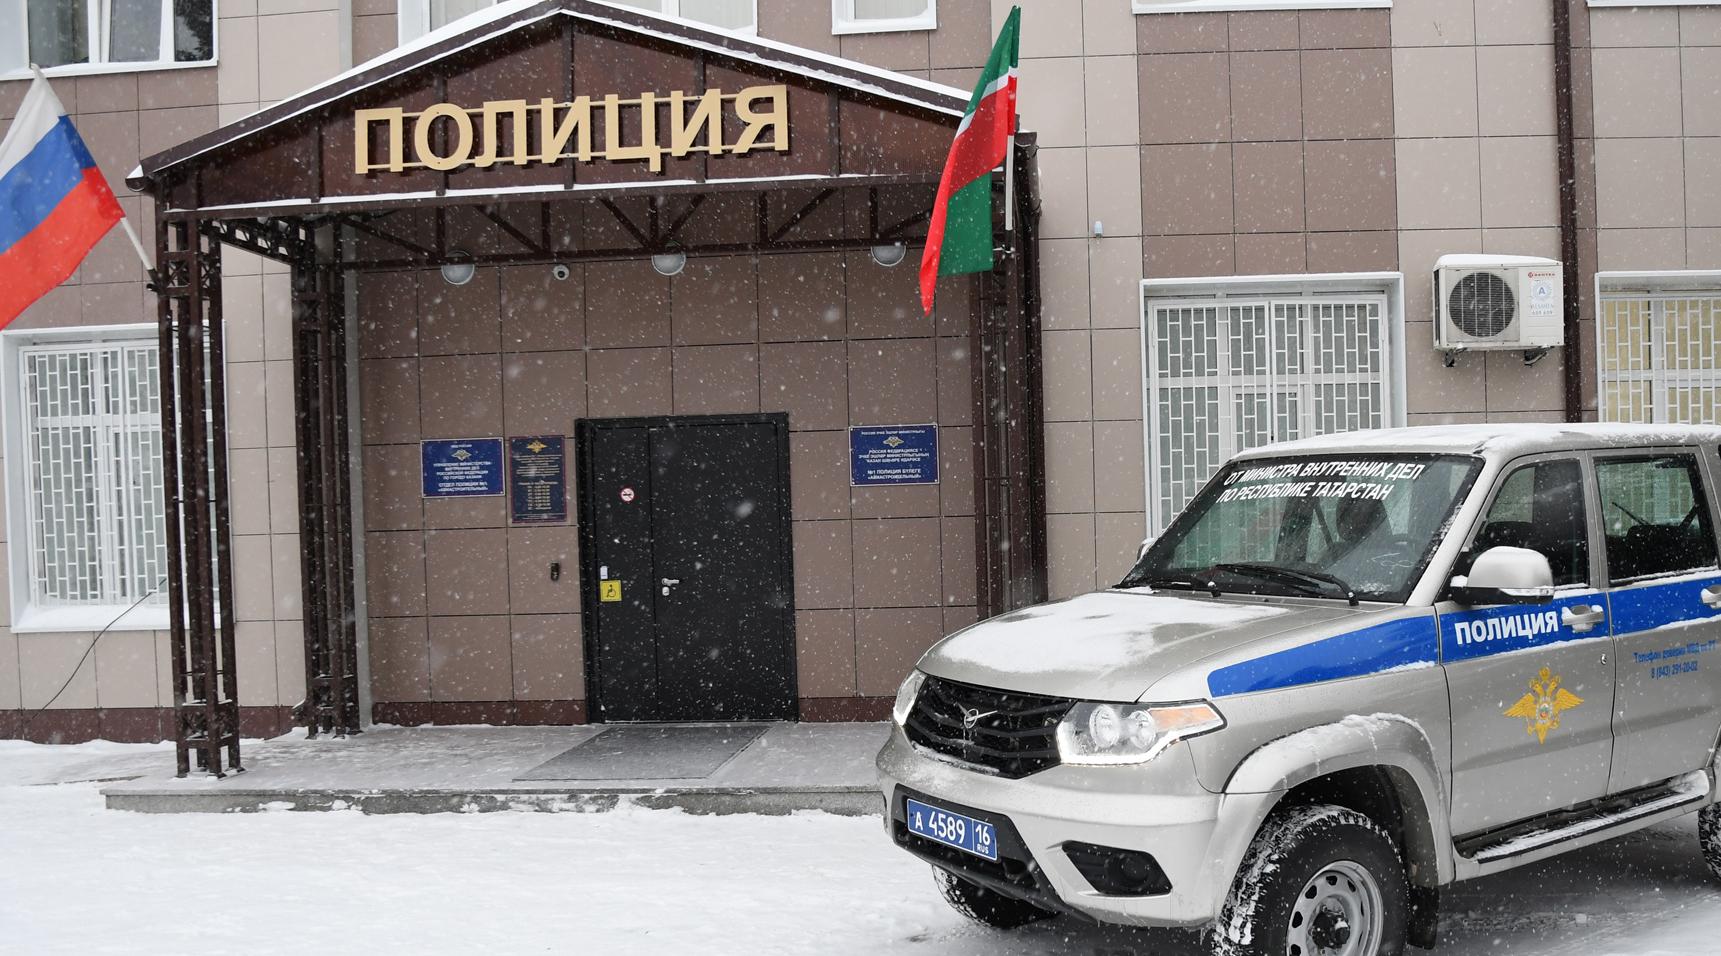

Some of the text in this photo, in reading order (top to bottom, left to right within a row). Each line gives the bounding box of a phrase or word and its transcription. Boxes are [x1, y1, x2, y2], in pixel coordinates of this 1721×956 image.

[355, 84, 789, 174] ПОЛИЦИЯ
[1223, 462, 1426, 486] ОТ МИНИСТРА ВНУТРЕННИХ ДЕЛ
[1216, 482, 1394, 504] ПО РЕСПУБЛИКЕ ТАТАРСТАН
[1454, 610, 1559, 645] ПОЛИЦИЯ
[928, 810, 966, 844] 4589
[975, 824, 991, 846] 16
[977, 844, 989, 855] RUS
